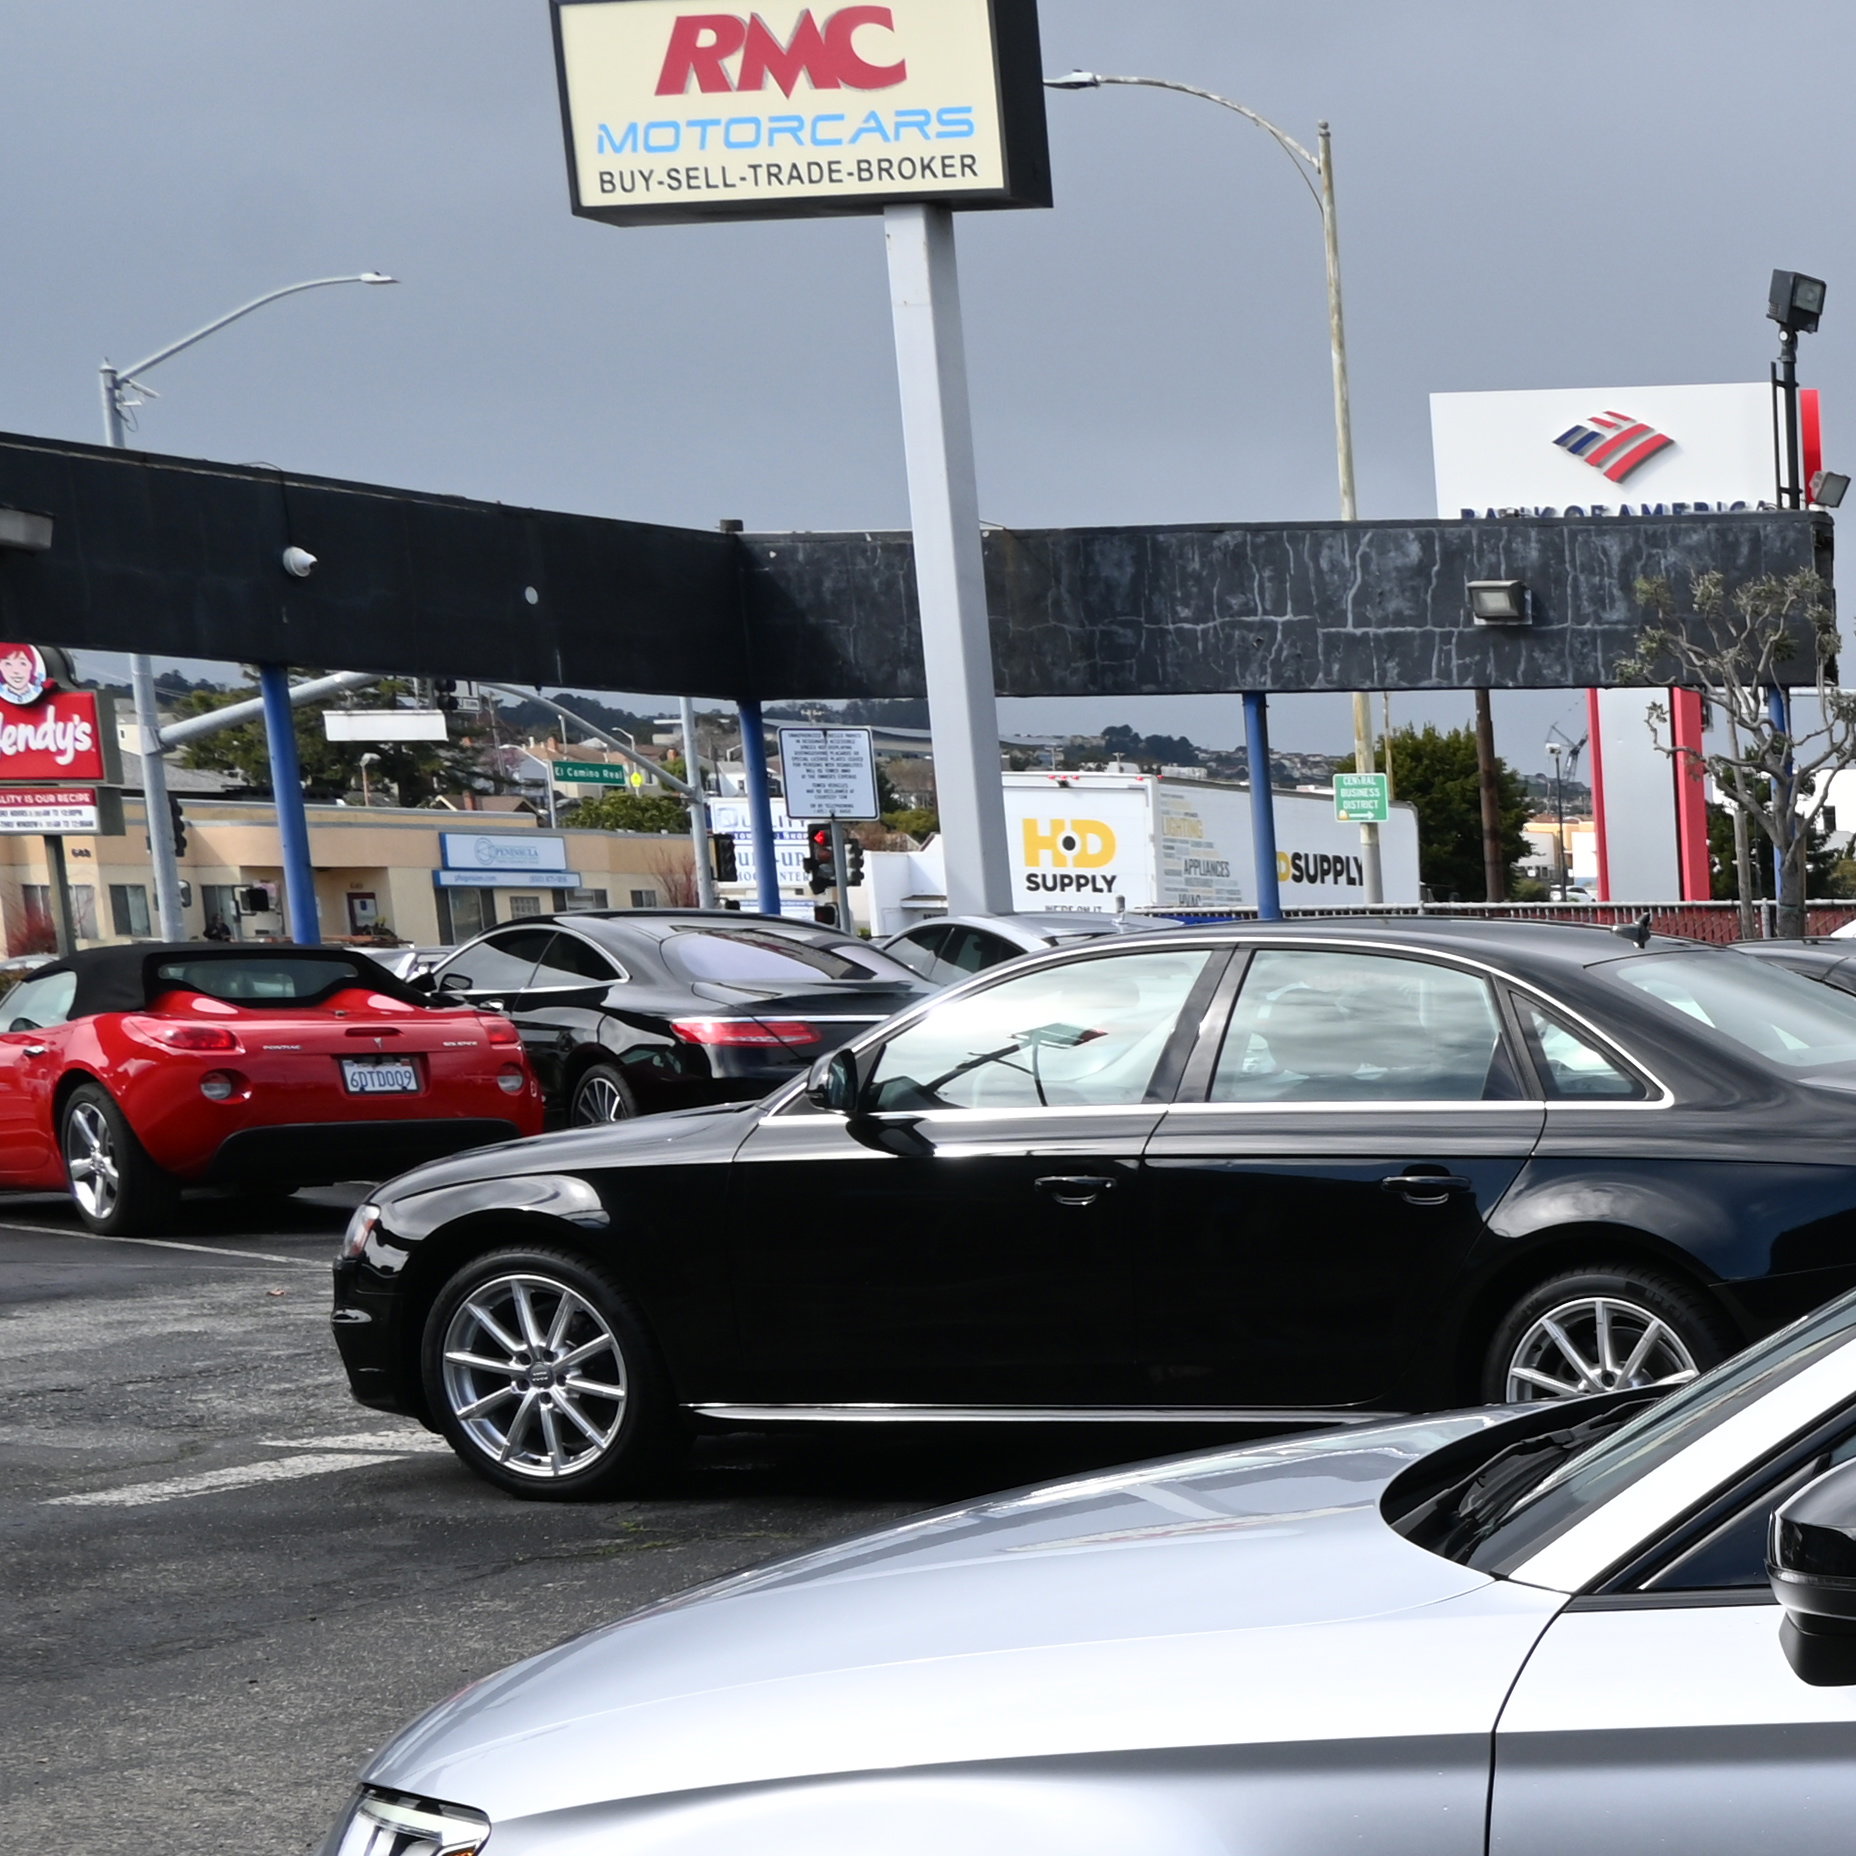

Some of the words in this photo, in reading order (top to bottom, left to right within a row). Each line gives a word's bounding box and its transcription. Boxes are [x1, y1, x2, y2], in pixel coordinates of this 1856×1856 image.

[654, 5, 907, 98] RMC
[597, 106, 976, 154] MOTORCARS
[599, 154, 978, 194] BUY-SELL-TRADE-BROKER
[554, 767, 564, 776] El
[566, 768, 600, 778] Camino
[602, 769, 622, 779] Real
[1341, 788, 1380, 797] BUSINESS
[1343, 800, 1378, 809] DISTRICT
[1022, 818, 1117, 869] HD
[1184, 858, 1230, 878] APPLIANCES
[1025, 873, 1117, 893] SUPPLY
[350, 1070, 412, 1088] 6DTD009
